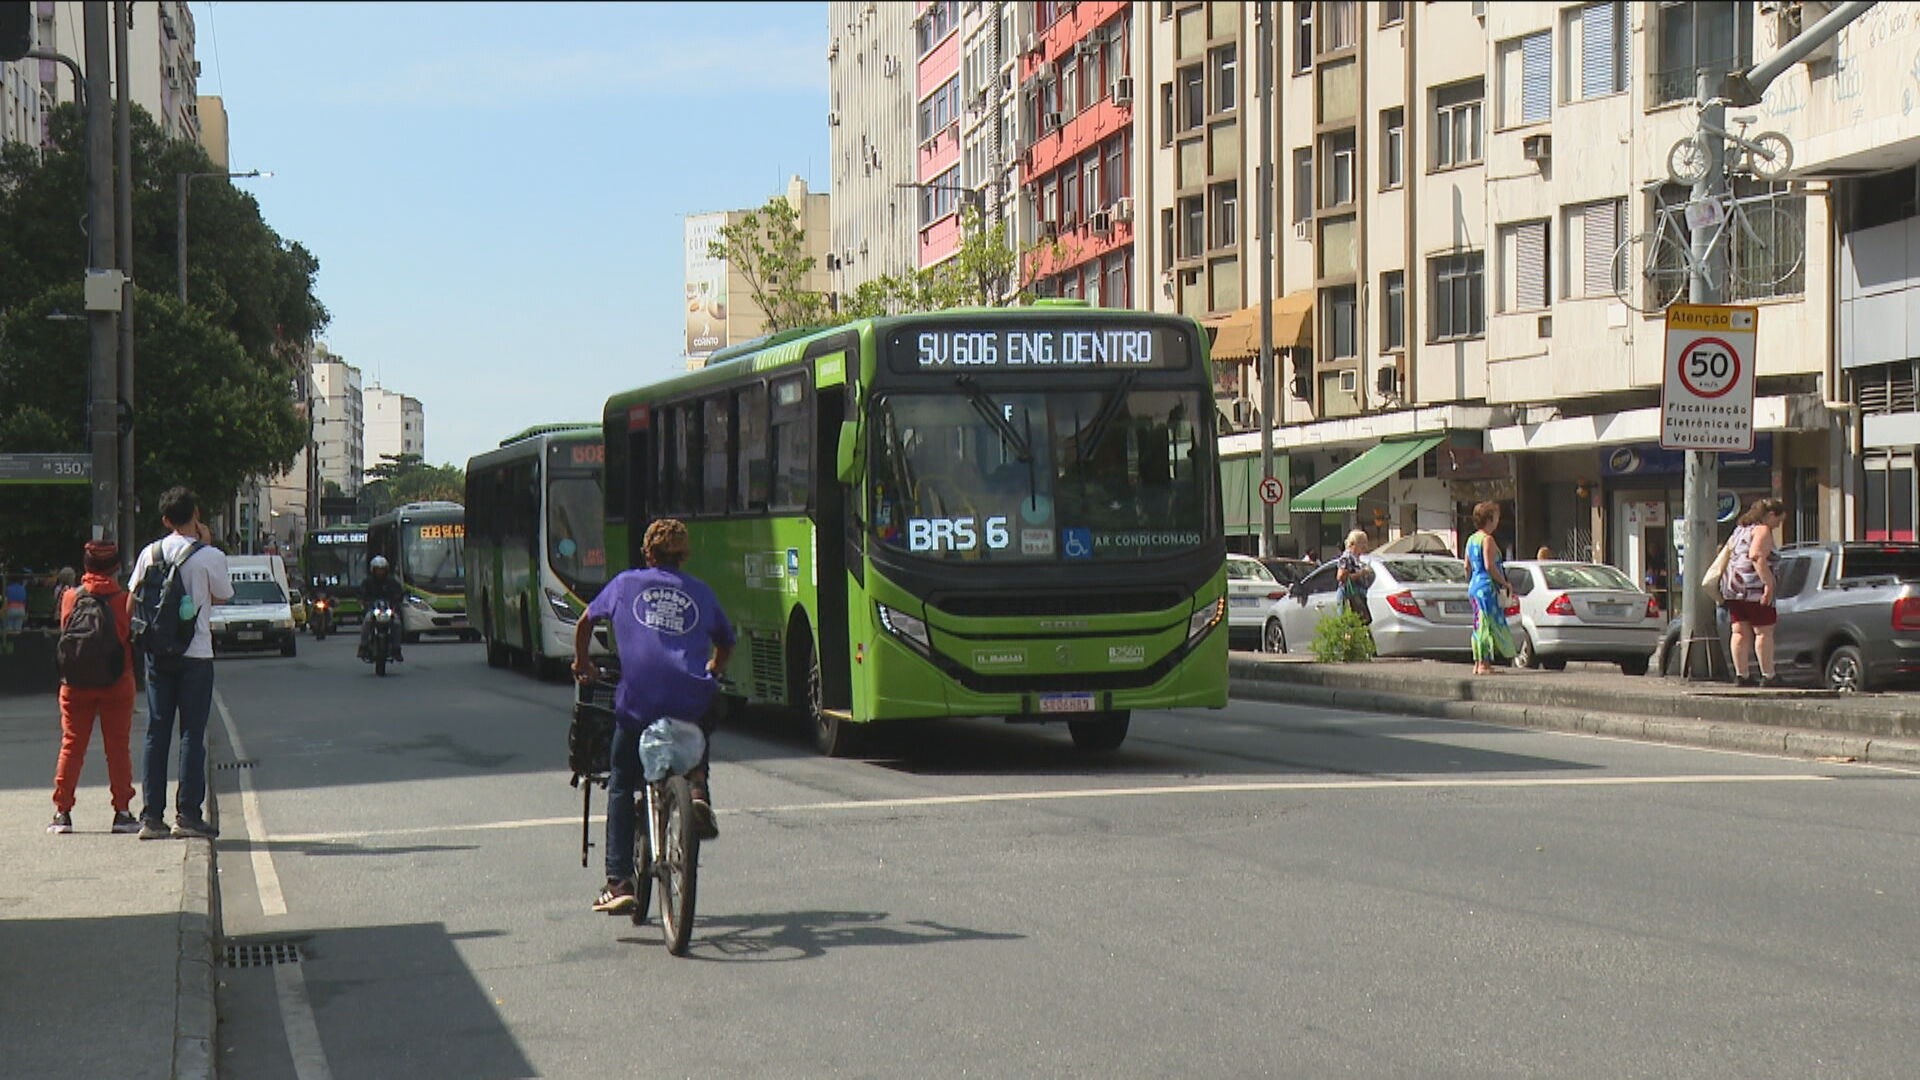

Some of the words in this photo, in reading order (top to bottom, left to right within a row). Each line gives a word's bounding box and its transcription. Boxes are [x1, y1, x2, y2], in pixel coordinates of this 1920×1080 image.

[1672, 311, 1728, 327] Atenção
[1690, 351, 1729, 378] 50
[1668, 402, 1747, 416] Fiscalização
[1666, 417, 1730, 430] Eletrônica
[1734, 420, 1748, 430] de
[1673, 432, 1740, 444] Velocidade
[909, 517, 977, 551] BRS
[986, 516, 1009, 549] 6
[1094, 536, 1110, 547] AR
[1115, 534, 1201, 546] CONDICIONADO
